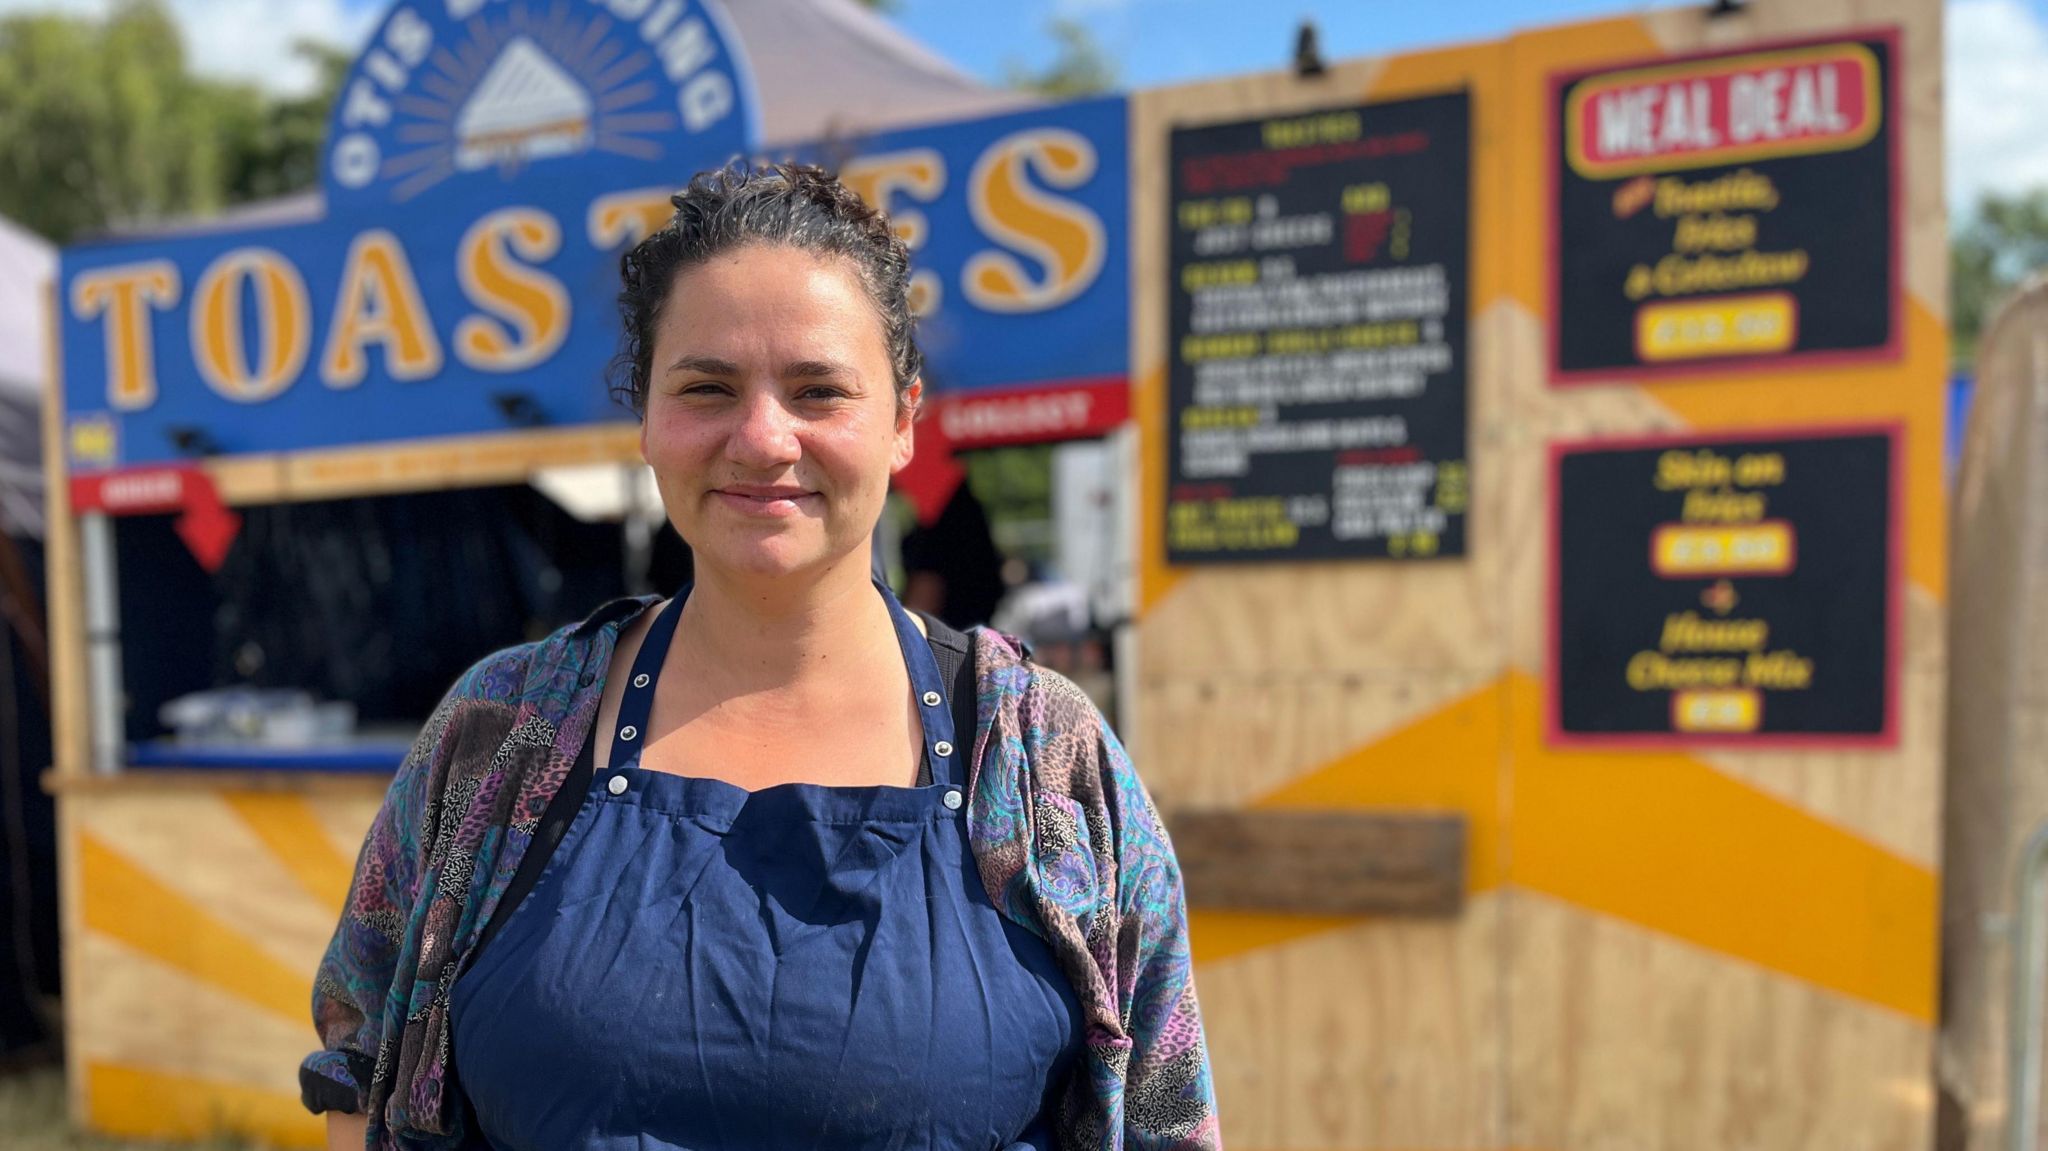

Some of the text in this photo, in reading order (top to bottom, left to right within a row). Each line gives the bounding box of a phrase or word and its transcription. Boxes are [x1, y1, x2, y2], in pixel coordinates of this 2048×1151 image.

[334, 7, 432, 188] OTIS
[1597, 64, 1848, 155] MEAL DEAL
[71, 128, 1107, 410] TOASES
[942, 393, 1089, 438] COLLECT
[1656, 450, 1784, 489] Skin on
